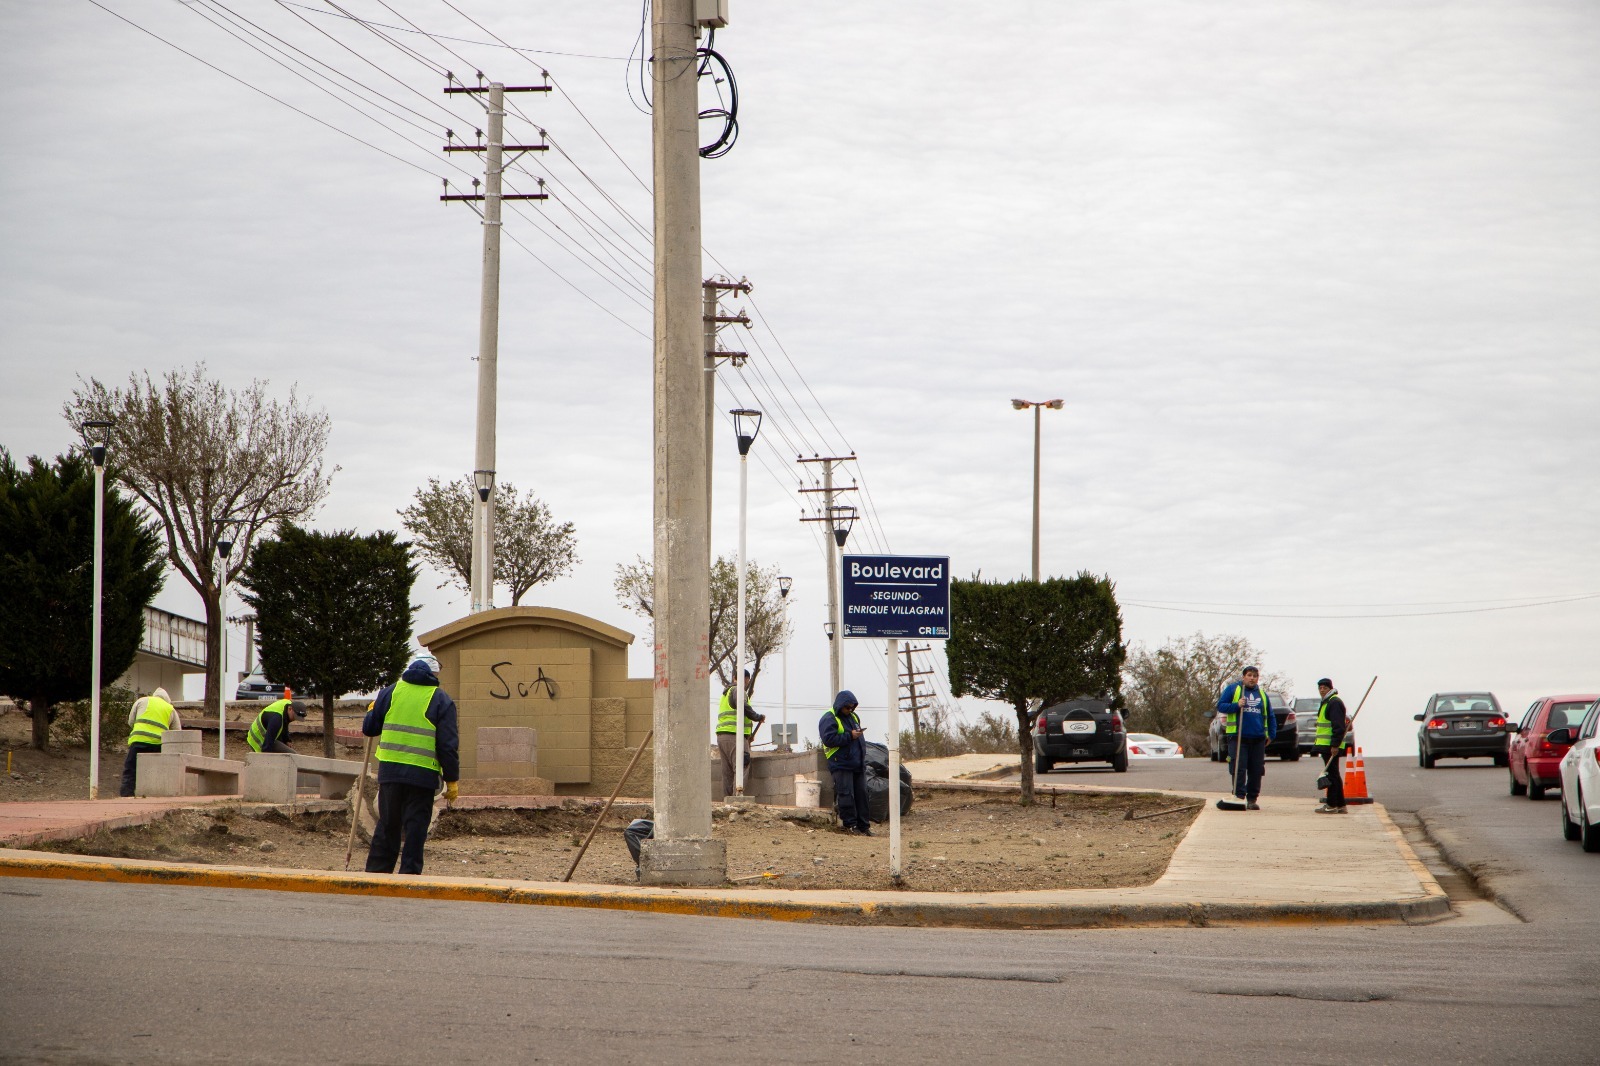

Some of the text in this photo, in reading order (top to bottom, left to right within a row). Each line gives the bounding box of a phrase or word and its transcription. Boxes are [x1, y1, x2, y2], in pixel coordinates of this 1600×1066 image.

[851, 562, 943, 579] Boulevard
[872, 591, 919, 601] SEGUNDO
[848, 605, 944, 615] ENRIQUE VILLAGRAN
